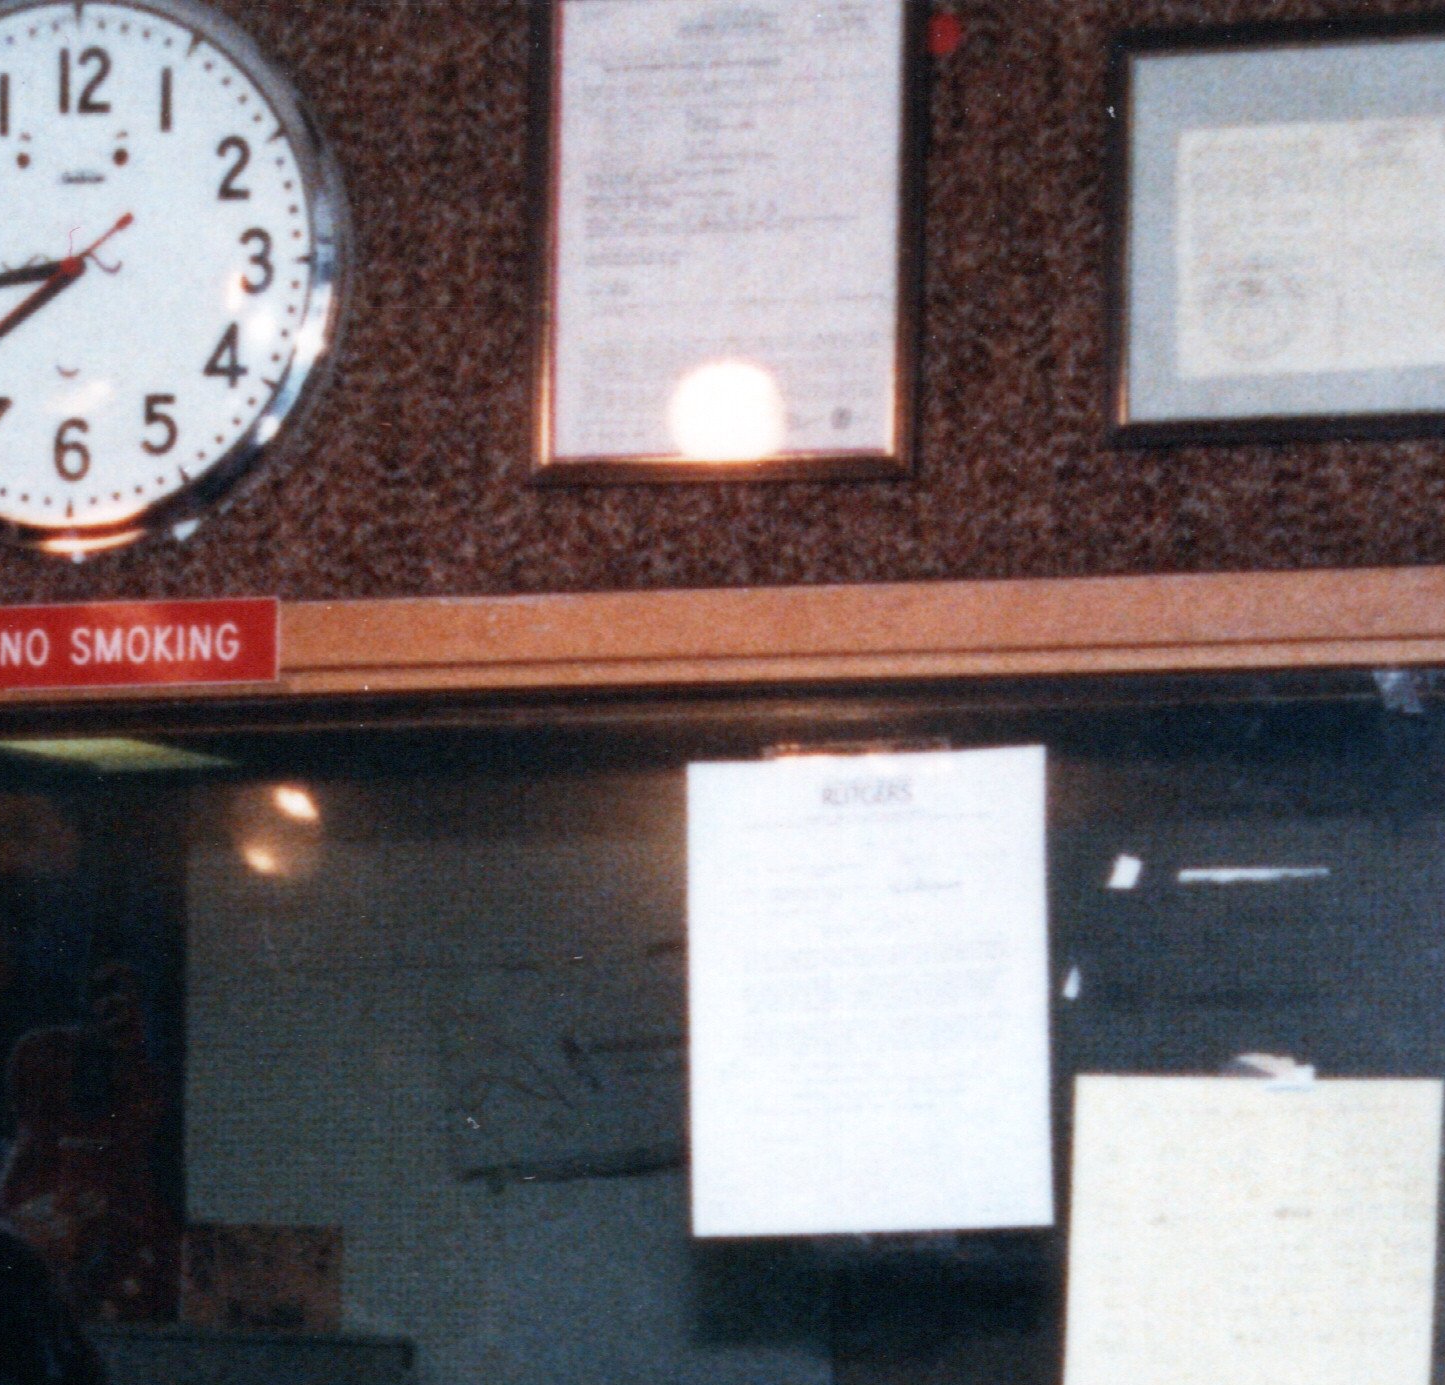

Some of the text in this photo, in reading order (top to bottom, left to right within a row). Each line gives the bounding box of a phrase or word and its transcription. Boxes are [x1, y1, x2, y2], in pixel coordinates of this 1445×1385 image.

[59, 46, 111, 114] 12
[160, 66, 172, 133] 1
[216, 135, 251, 201] 2
[239, 228, 274, 295] 3
[203, 322, 248, 388] 4
[53, 418, 90, 482] 6
[142, 394, 179, 456] 5
[69, 622, 241, 666] SMOKING
